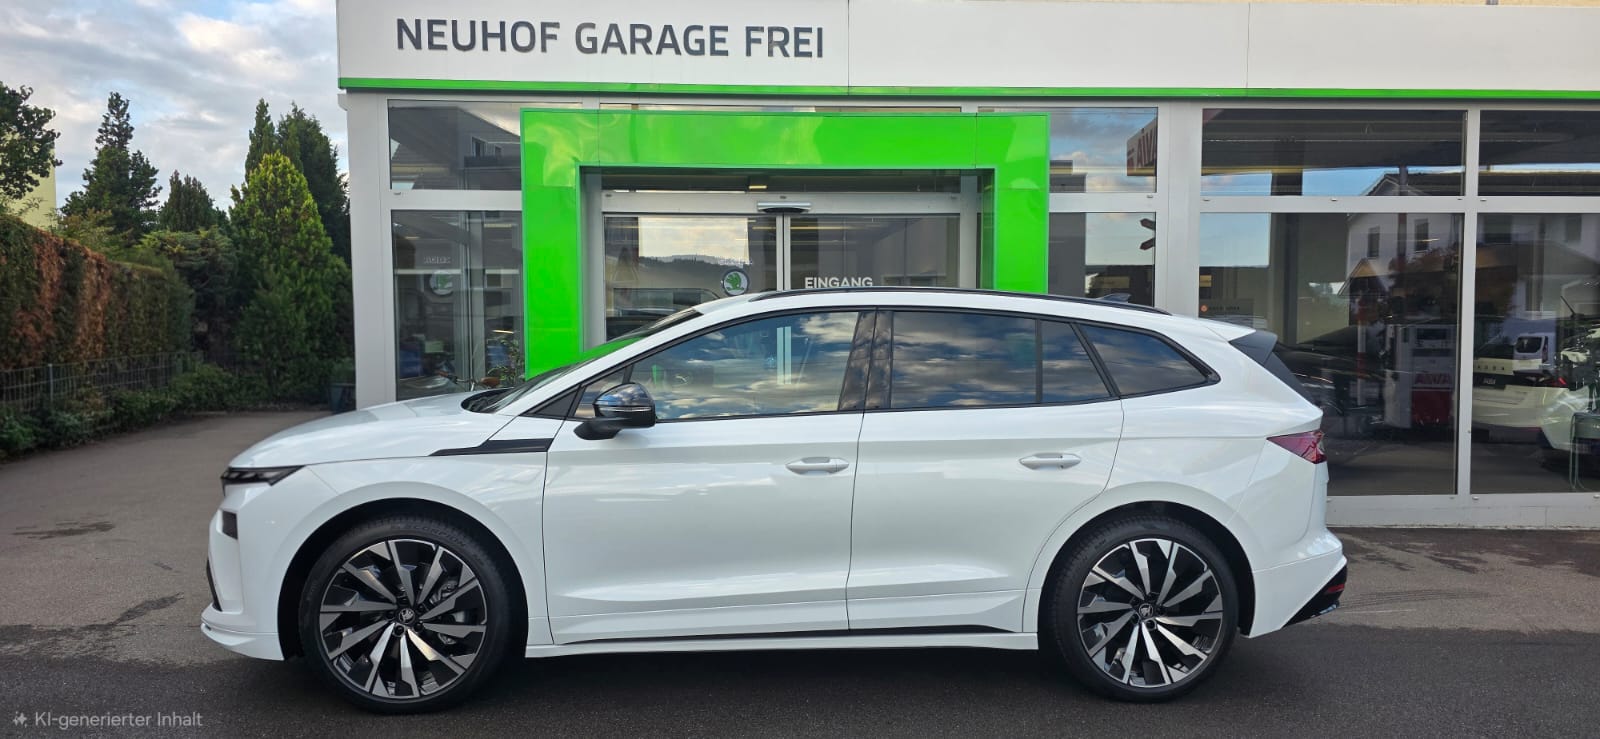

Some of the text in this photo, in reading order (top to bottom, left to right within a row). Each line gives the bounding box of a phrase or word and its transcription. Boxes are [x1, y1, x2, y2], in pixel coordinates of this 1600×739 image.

[397, 18, 824, 58] NEUHOF GARAGE FREI
[804, 276, 873, 288] EINGANG
